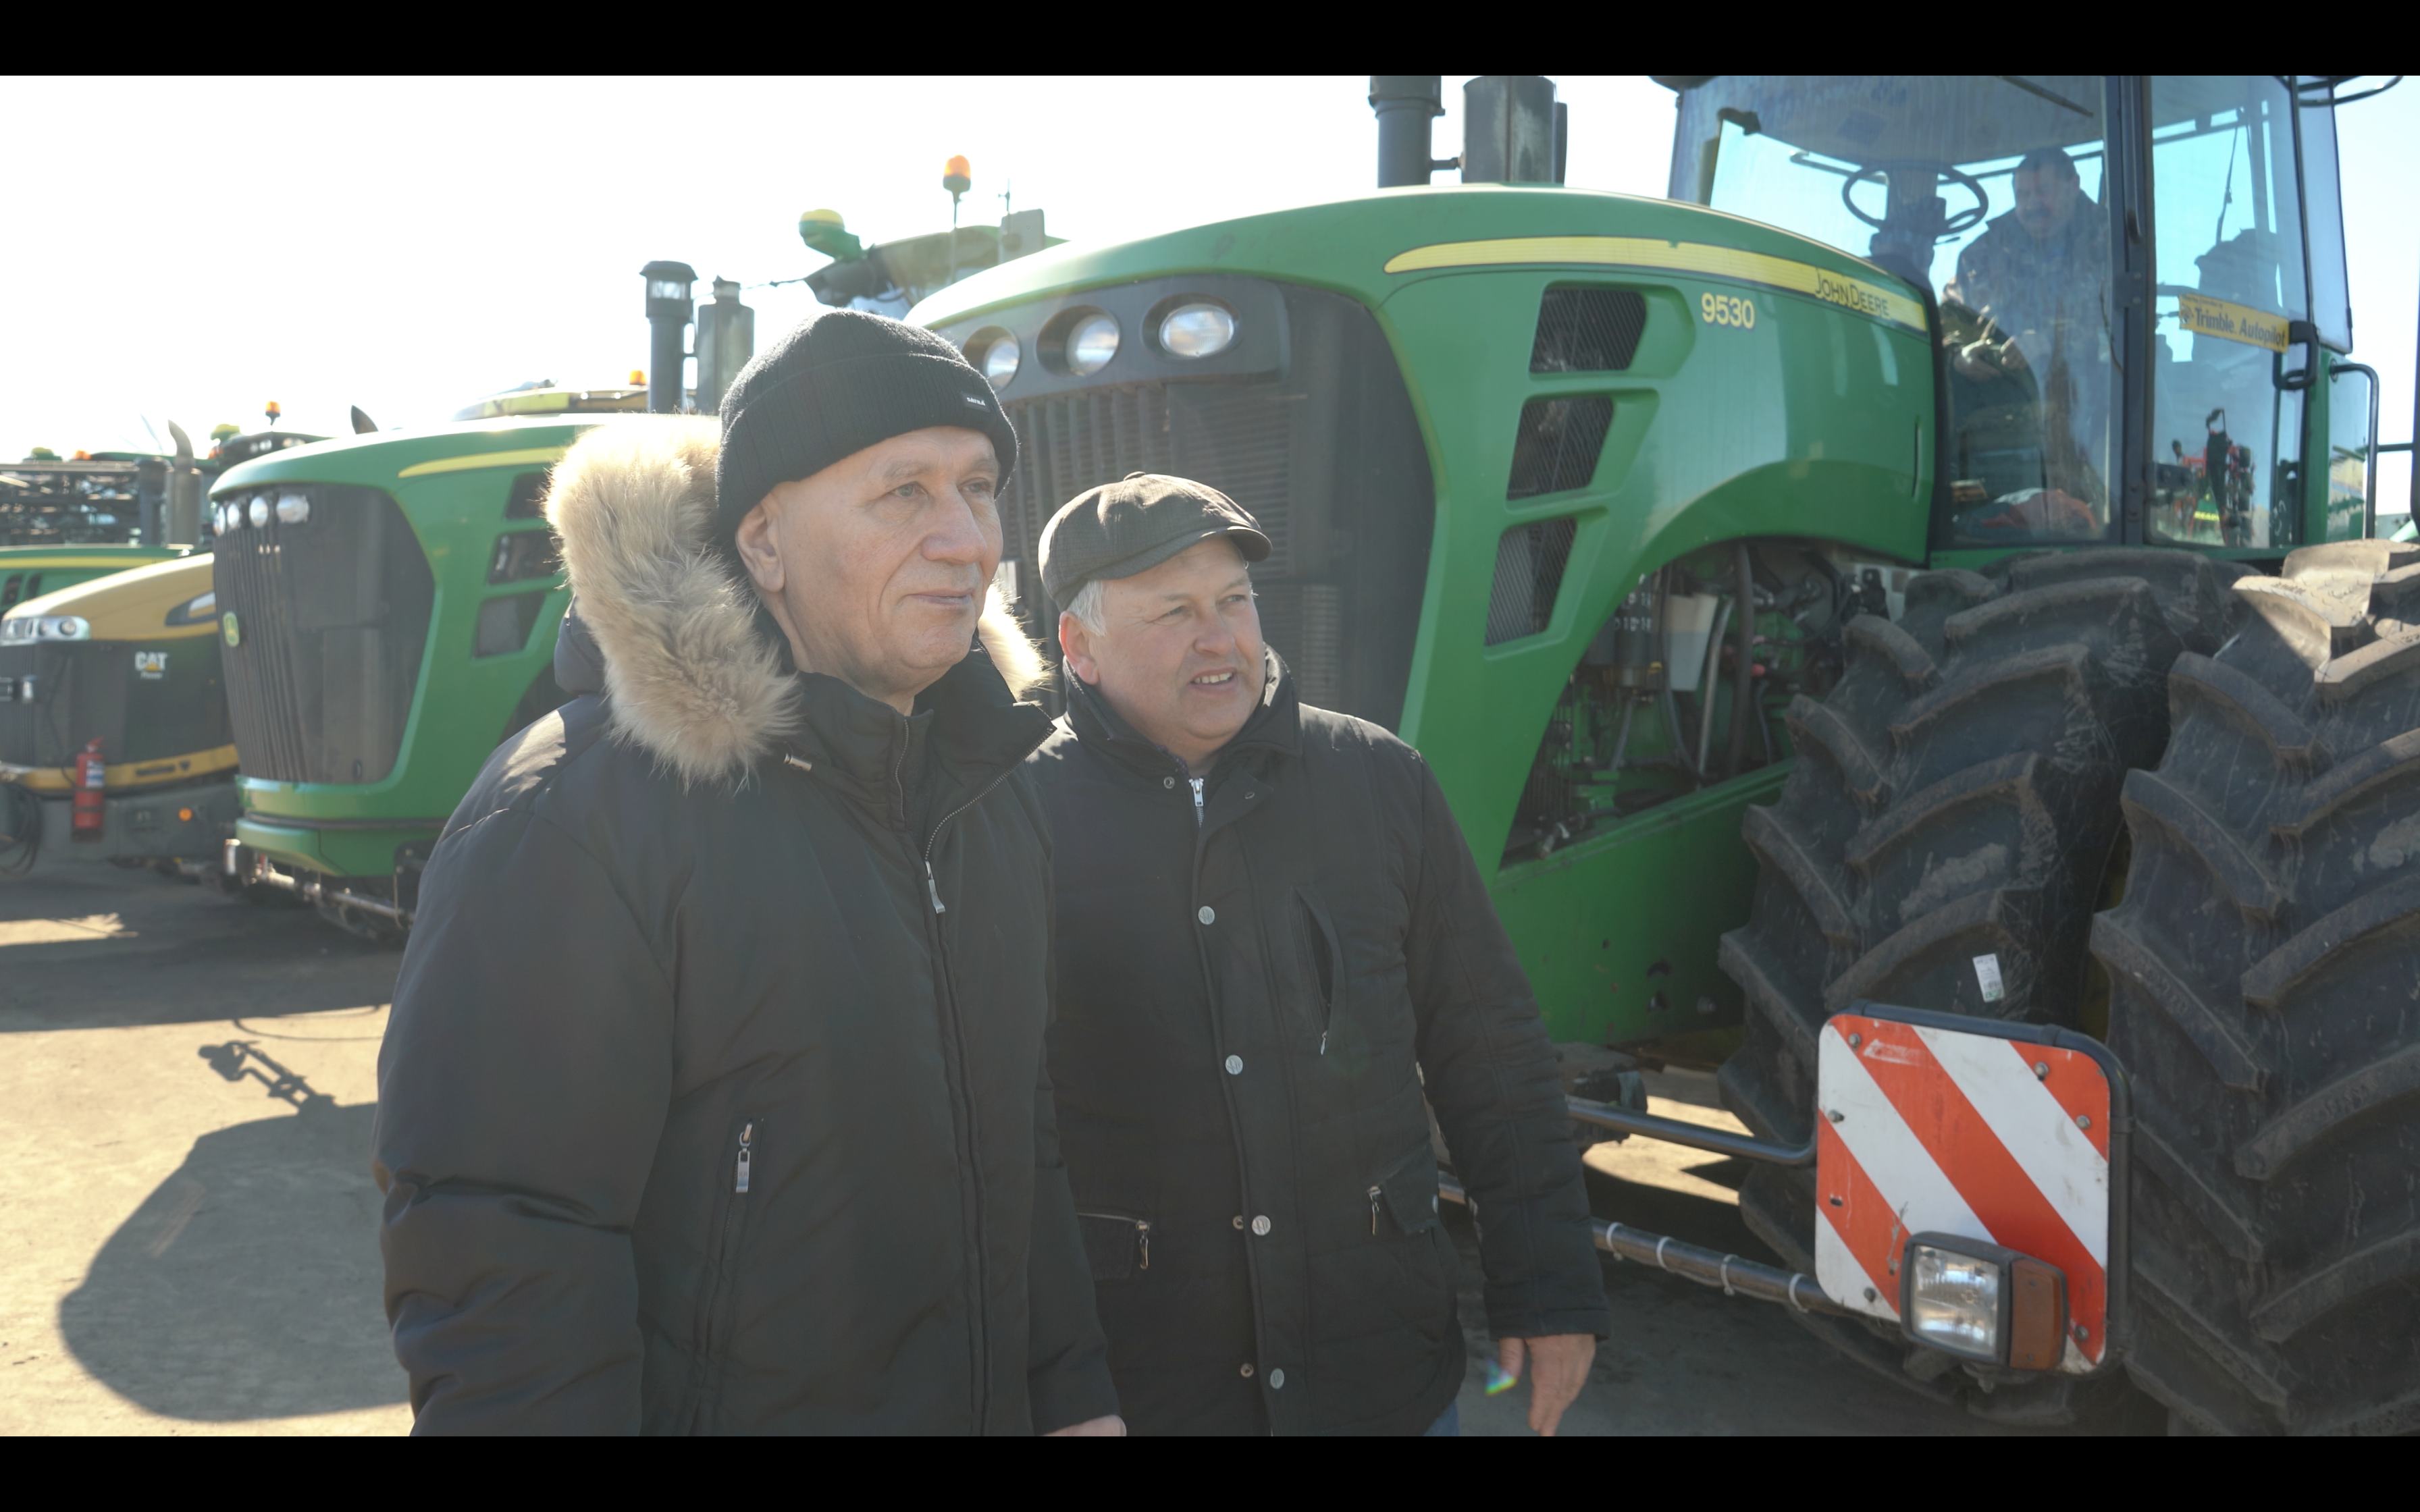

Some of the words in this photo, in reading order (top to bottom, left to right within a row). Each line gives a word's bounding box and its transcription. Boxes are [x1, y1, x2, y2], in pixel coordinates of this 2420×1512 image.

[1701, 292, 1755, 329] 9530
[1815, 269, 1850, 305] JOHN
[1850, 283, 1890, 317] DEERE
[2195, 307, 2235, 333] Trimble
[2239, 317, 2286, 348] Autopilot
[135, 651, 169, 671] CAT
